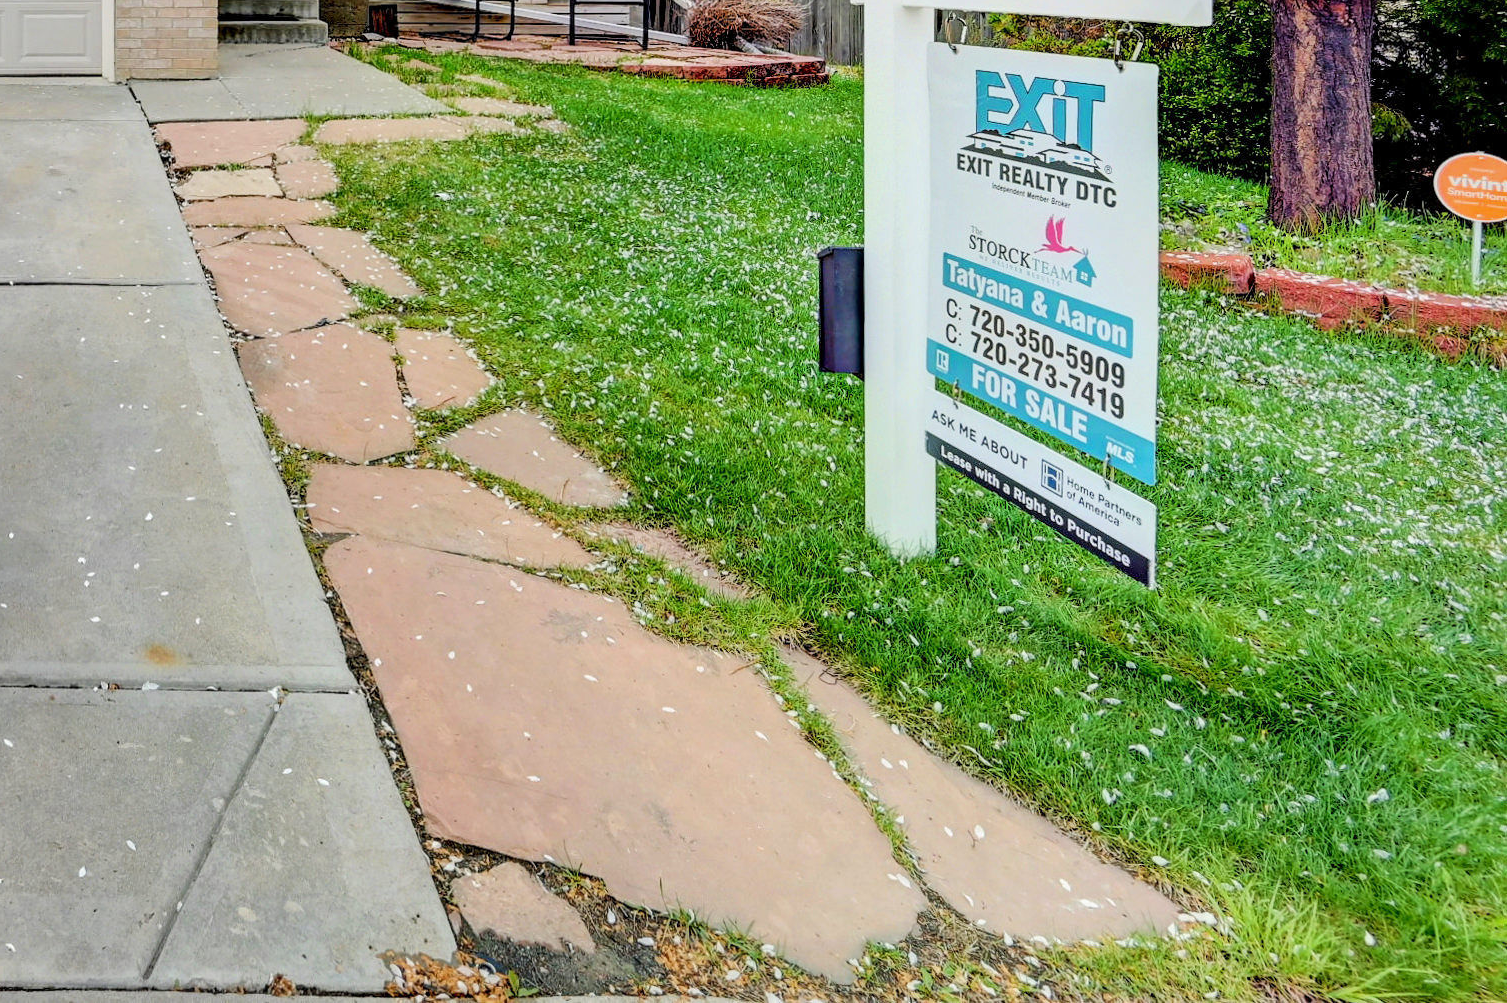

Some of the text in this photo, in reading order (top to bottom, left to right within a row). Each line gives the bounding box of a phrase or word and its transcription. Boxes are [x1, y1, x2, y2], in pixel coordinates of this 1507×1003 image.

[957, 153, 1117, 208] EXIT REALTY DTC
[992, 182, 1071, 209] Independent Member Broker
[947, 258, 1128, 348] Tatyana & Aaron
[945, 323, 1125, 419] C: 720-273-7419
[946, 298, 1125, 389] C: 720-350-5909
[971, 362, 1088, 444] FOR SALE
[931, 410, 1028, 469] ASK ME ABOUT
[1106, 441, 1135, 464] MLS
[940, 444, 1131, 567] Lease with a Right to Purchase
[1066, 491, 1120, 526] of America
[1067, 476, 1142, 526] Home Partners
